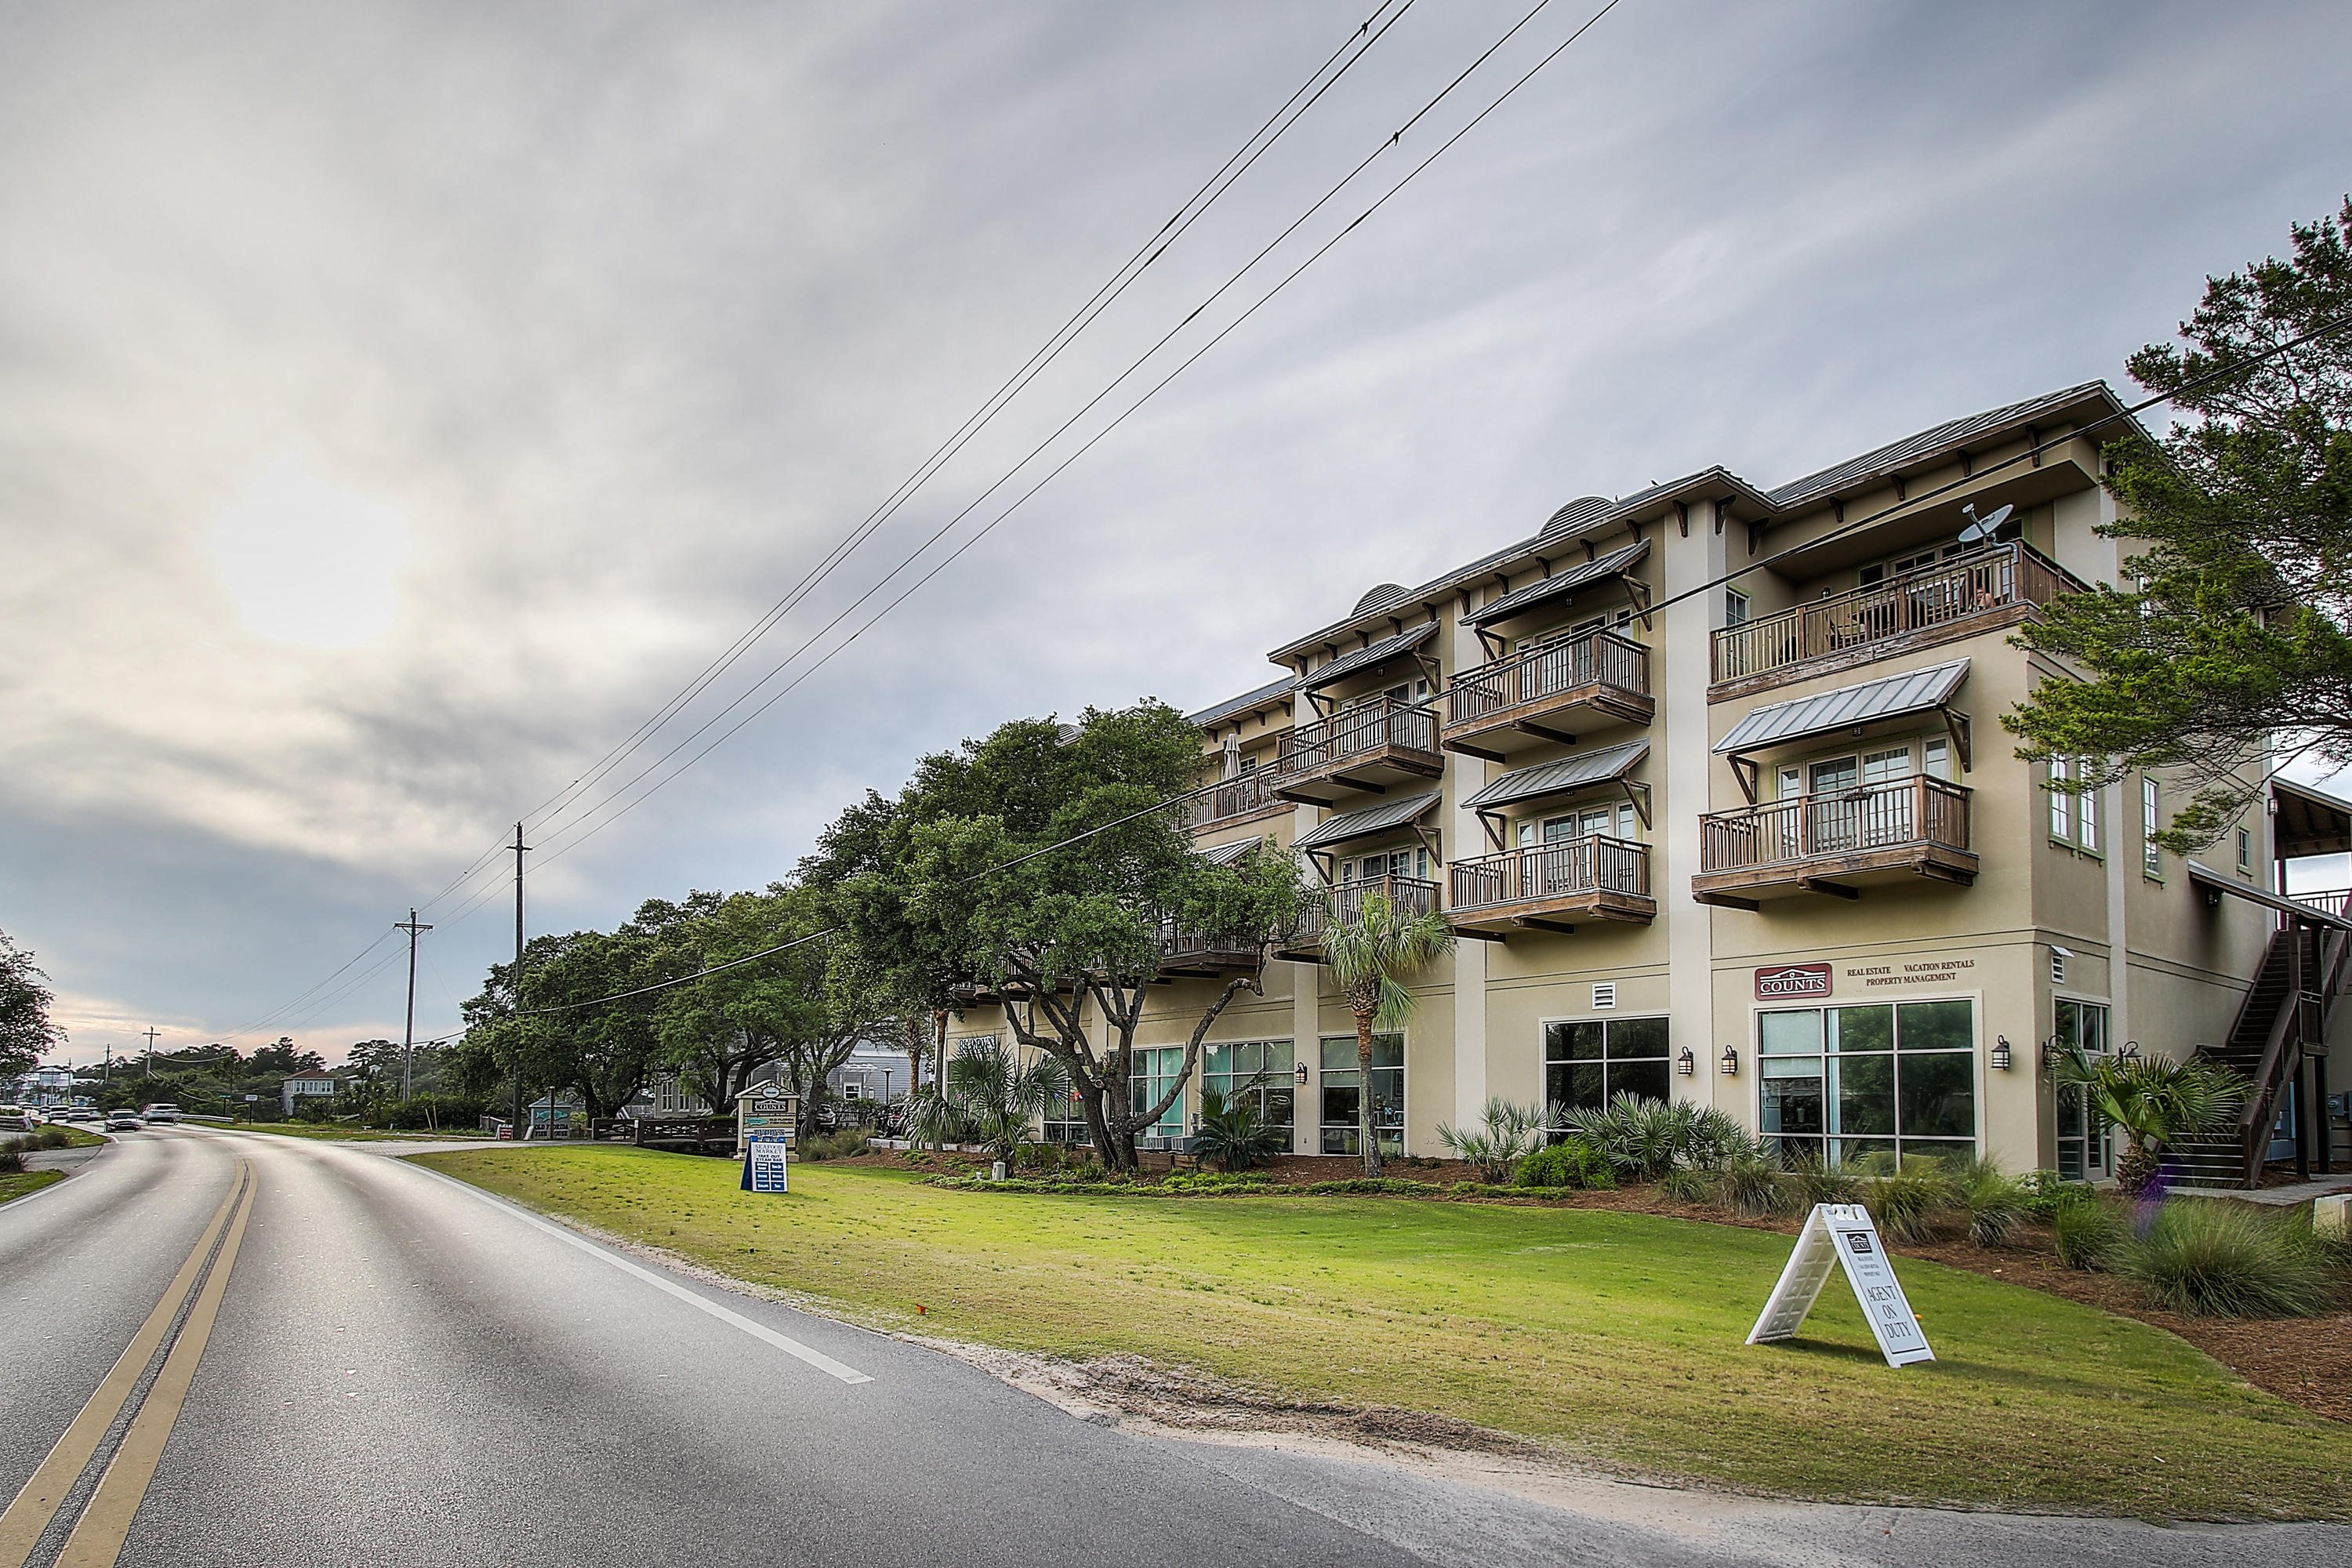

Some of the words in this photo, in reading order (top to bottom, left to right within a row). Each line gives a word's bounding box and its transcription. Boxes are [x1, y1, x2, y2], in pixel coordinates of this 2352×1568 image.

[1904, 964, 1940, 972] VACATION
[1941, 960, 1975, 970] RENTALS
[1760, 978, 1825, 993] COUNTS
[1866, 977, 1903, 986] PROPERTY
[1904, 972, 1956, 983] MANAGEMENT
[1867, 1285, 1896, 1301] AGENT
[1882, 1304, 1898, 1319] ON
[1884, 1321, 1912, 1339] DUTY
